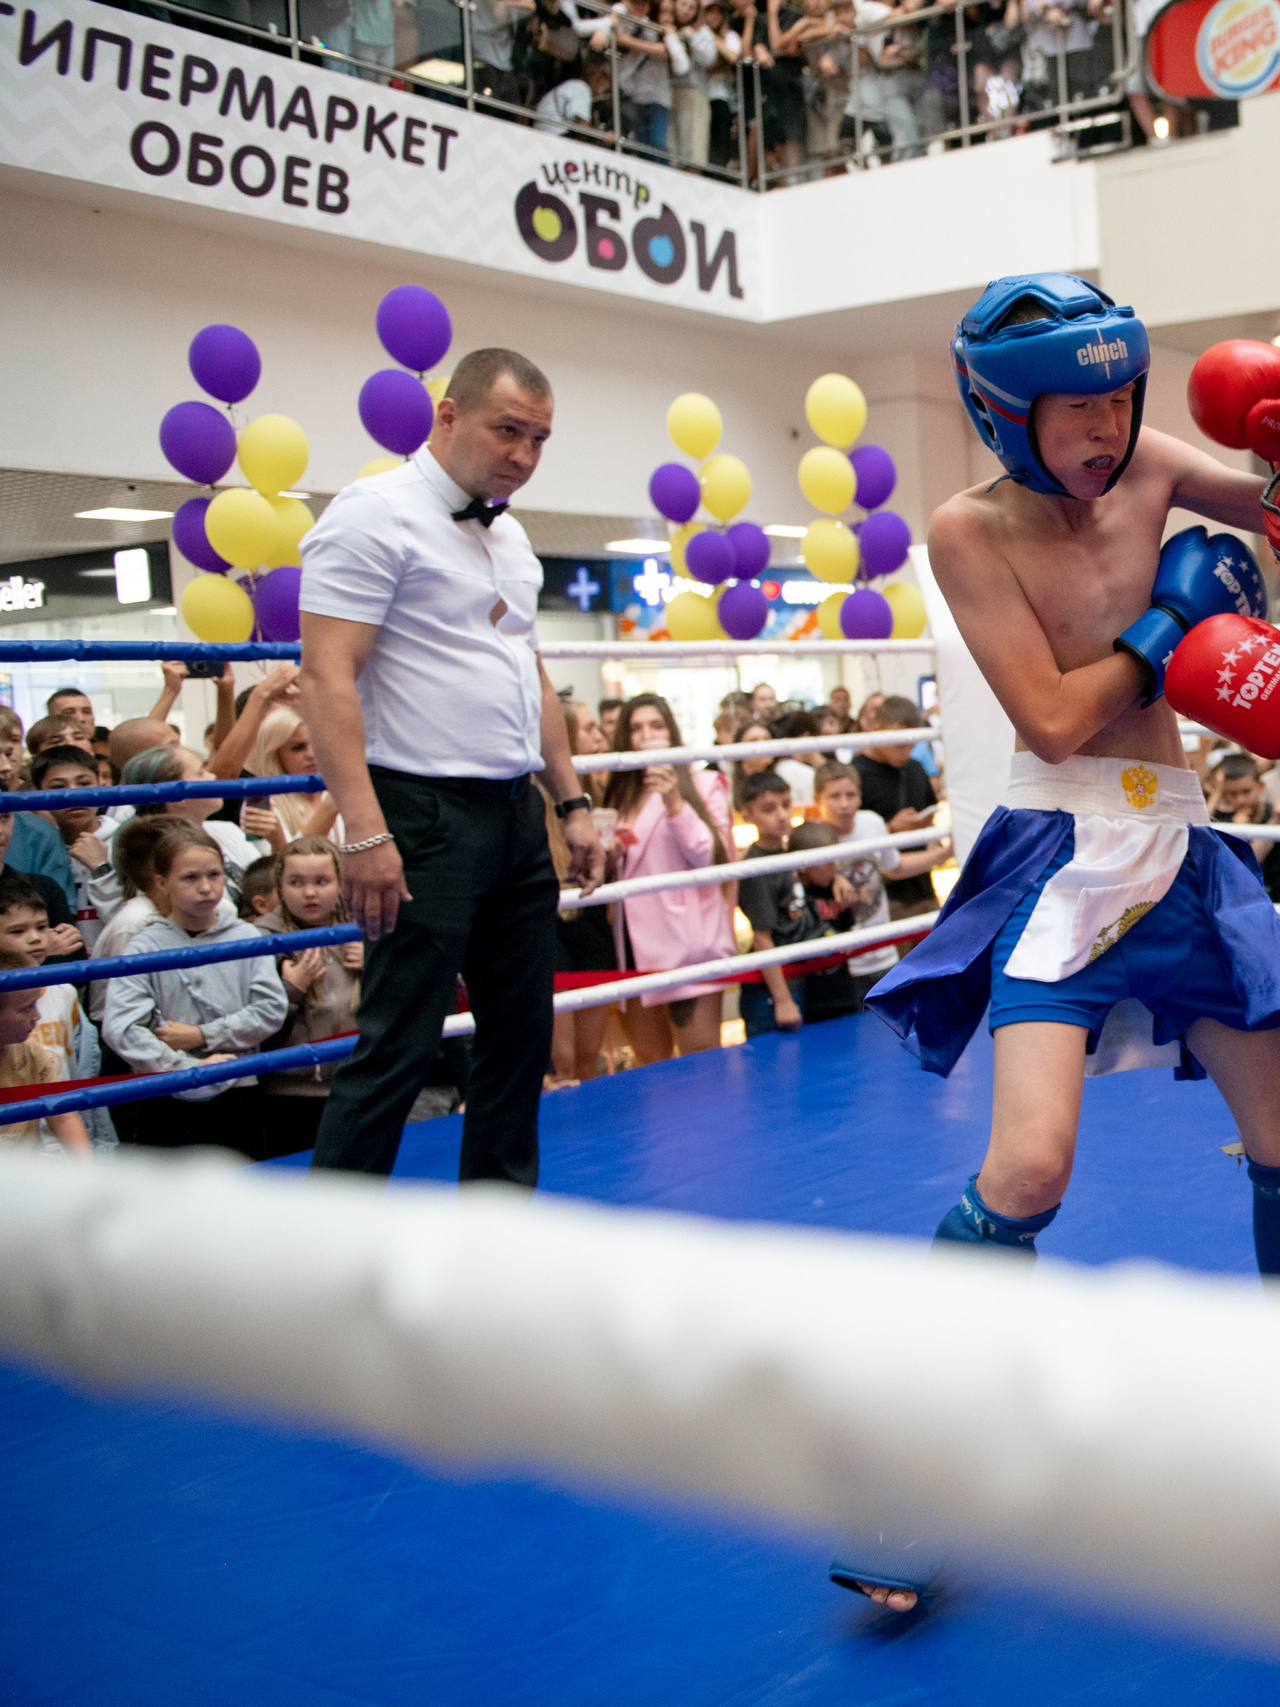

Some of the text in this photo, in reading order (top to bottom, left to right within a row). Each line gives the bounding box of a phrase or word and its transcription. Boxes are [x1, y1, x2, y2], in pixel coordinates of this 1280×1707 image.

[129, 120, 350, 217] ОБОЕВ
[514, 178, 745, 300] ОБОИ
[1076, 337, 1129, 367] clinch
